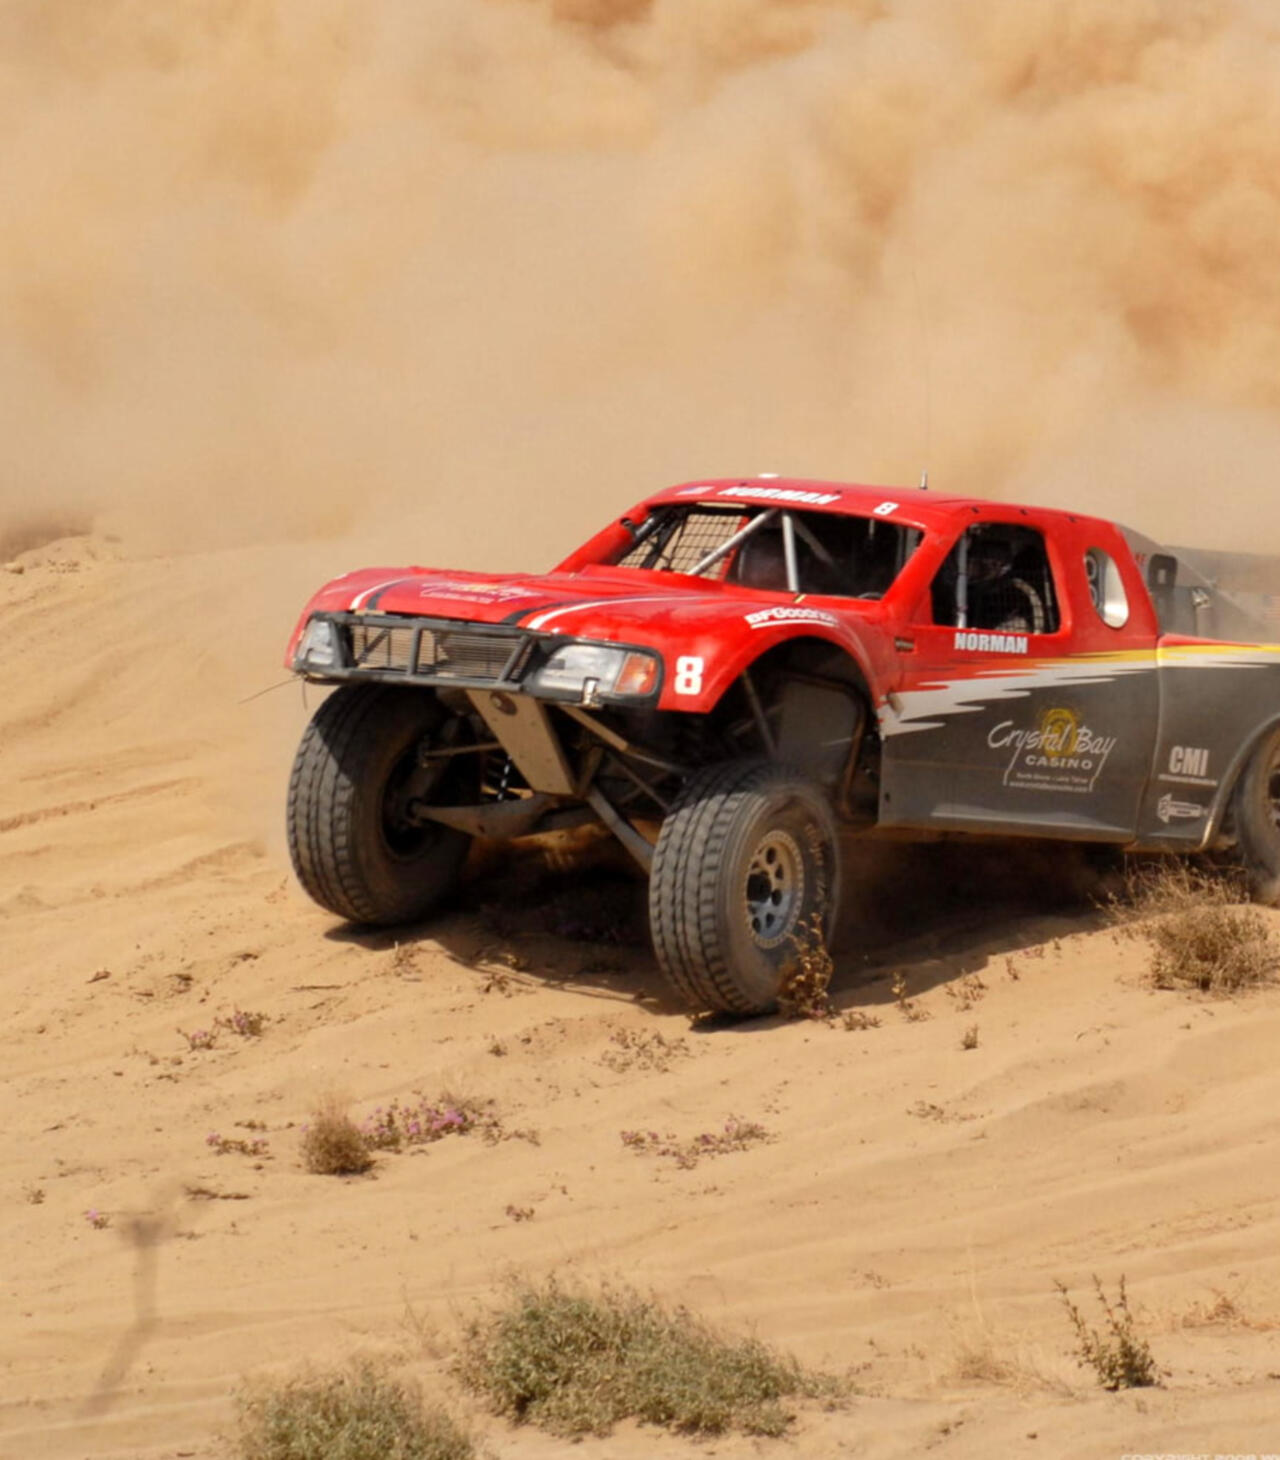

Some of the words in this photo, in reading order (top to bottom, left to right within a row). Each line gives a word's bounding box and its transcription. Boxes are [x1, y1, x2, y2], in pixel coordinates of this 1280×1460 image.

[717, 486, 842, 506] NORMAN
[873, 501, 899, 516] 8
[954, 632, 1028, 654] NORMAN
[674, 655, 704, 696] 8
[988, 720, 1072, 764] Crystal
[1072, 725, 1117, 762] Bay
[1025, 754, 1093, 770] CASINO
[1168, 745, 1209, 776] CMI
